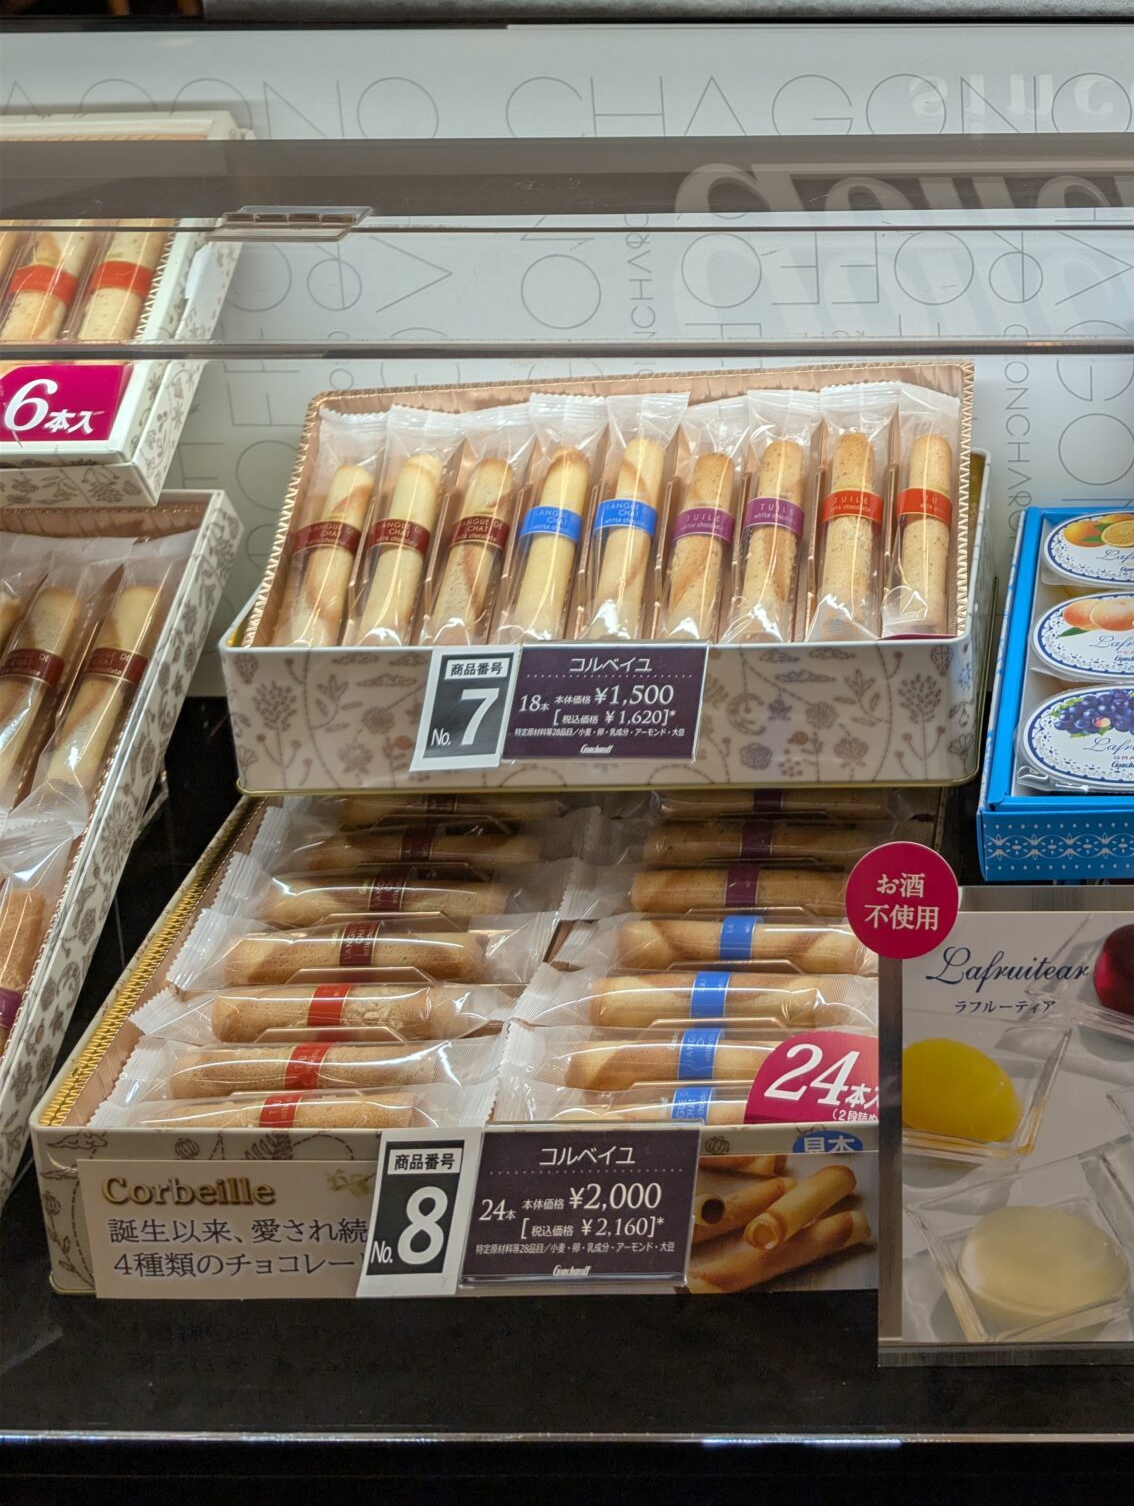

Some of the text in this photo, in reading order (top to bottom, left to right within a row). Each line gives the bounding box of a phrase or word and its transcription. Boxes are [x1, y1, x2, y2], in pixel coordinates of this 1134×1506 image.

[451, 662, 503, 676] 商品番号
[569, 657, 653, 672] コルベイユ
[554, 694, 592, 705] 本体価格
[595, 684, 675, 706] ¥1,500
[430, 687, 500, 746] No. 7
[876, 873, 926, 899] お酒
[864, 904, 940, 931] 不使用
[926, 946, 1089, 993] Lafruitear
[954, 1000, 1057, 1014] ラフルーティア
[394, 1152, 456, 1171] 商品番号
[539, 1146, 636, 1167] コルベイユ
[102, 1176, 276, 1206] Corbeille
[522, 1197, 565, 1211] 本体価格
[568, 1182, 663, 1212] ¥2,000
[108, 1217, 368, 1244] 誕生以来、愛され続
[370, 1185, 448, 1266] No. 8
[114, 1251, 363, 1278] 4種類のチョコレー
